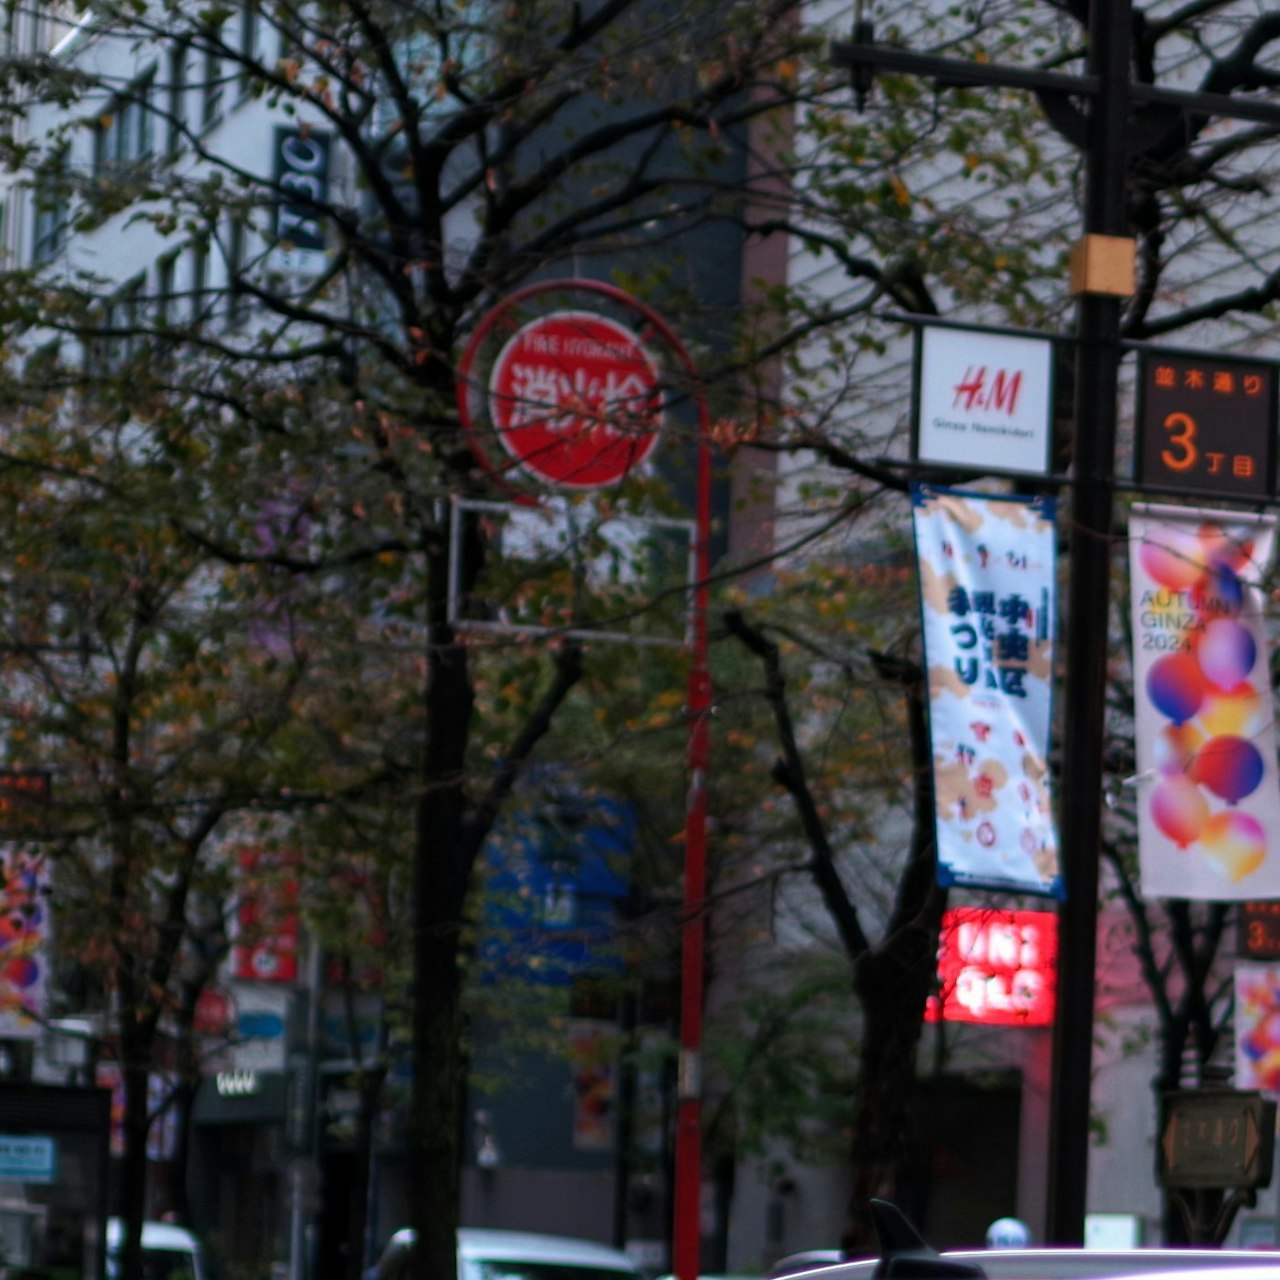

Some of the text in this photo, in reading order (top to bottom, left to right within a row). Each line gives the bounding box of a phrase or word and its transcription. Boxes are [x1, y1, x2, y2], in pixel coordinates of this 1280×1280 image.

[523, 333, 558, 353] FIRE
[952, 364, 1024, 416] H&M
[1139, 610, 1207, 633] GINZA
[1142, 631, 1192, 653] 2024
